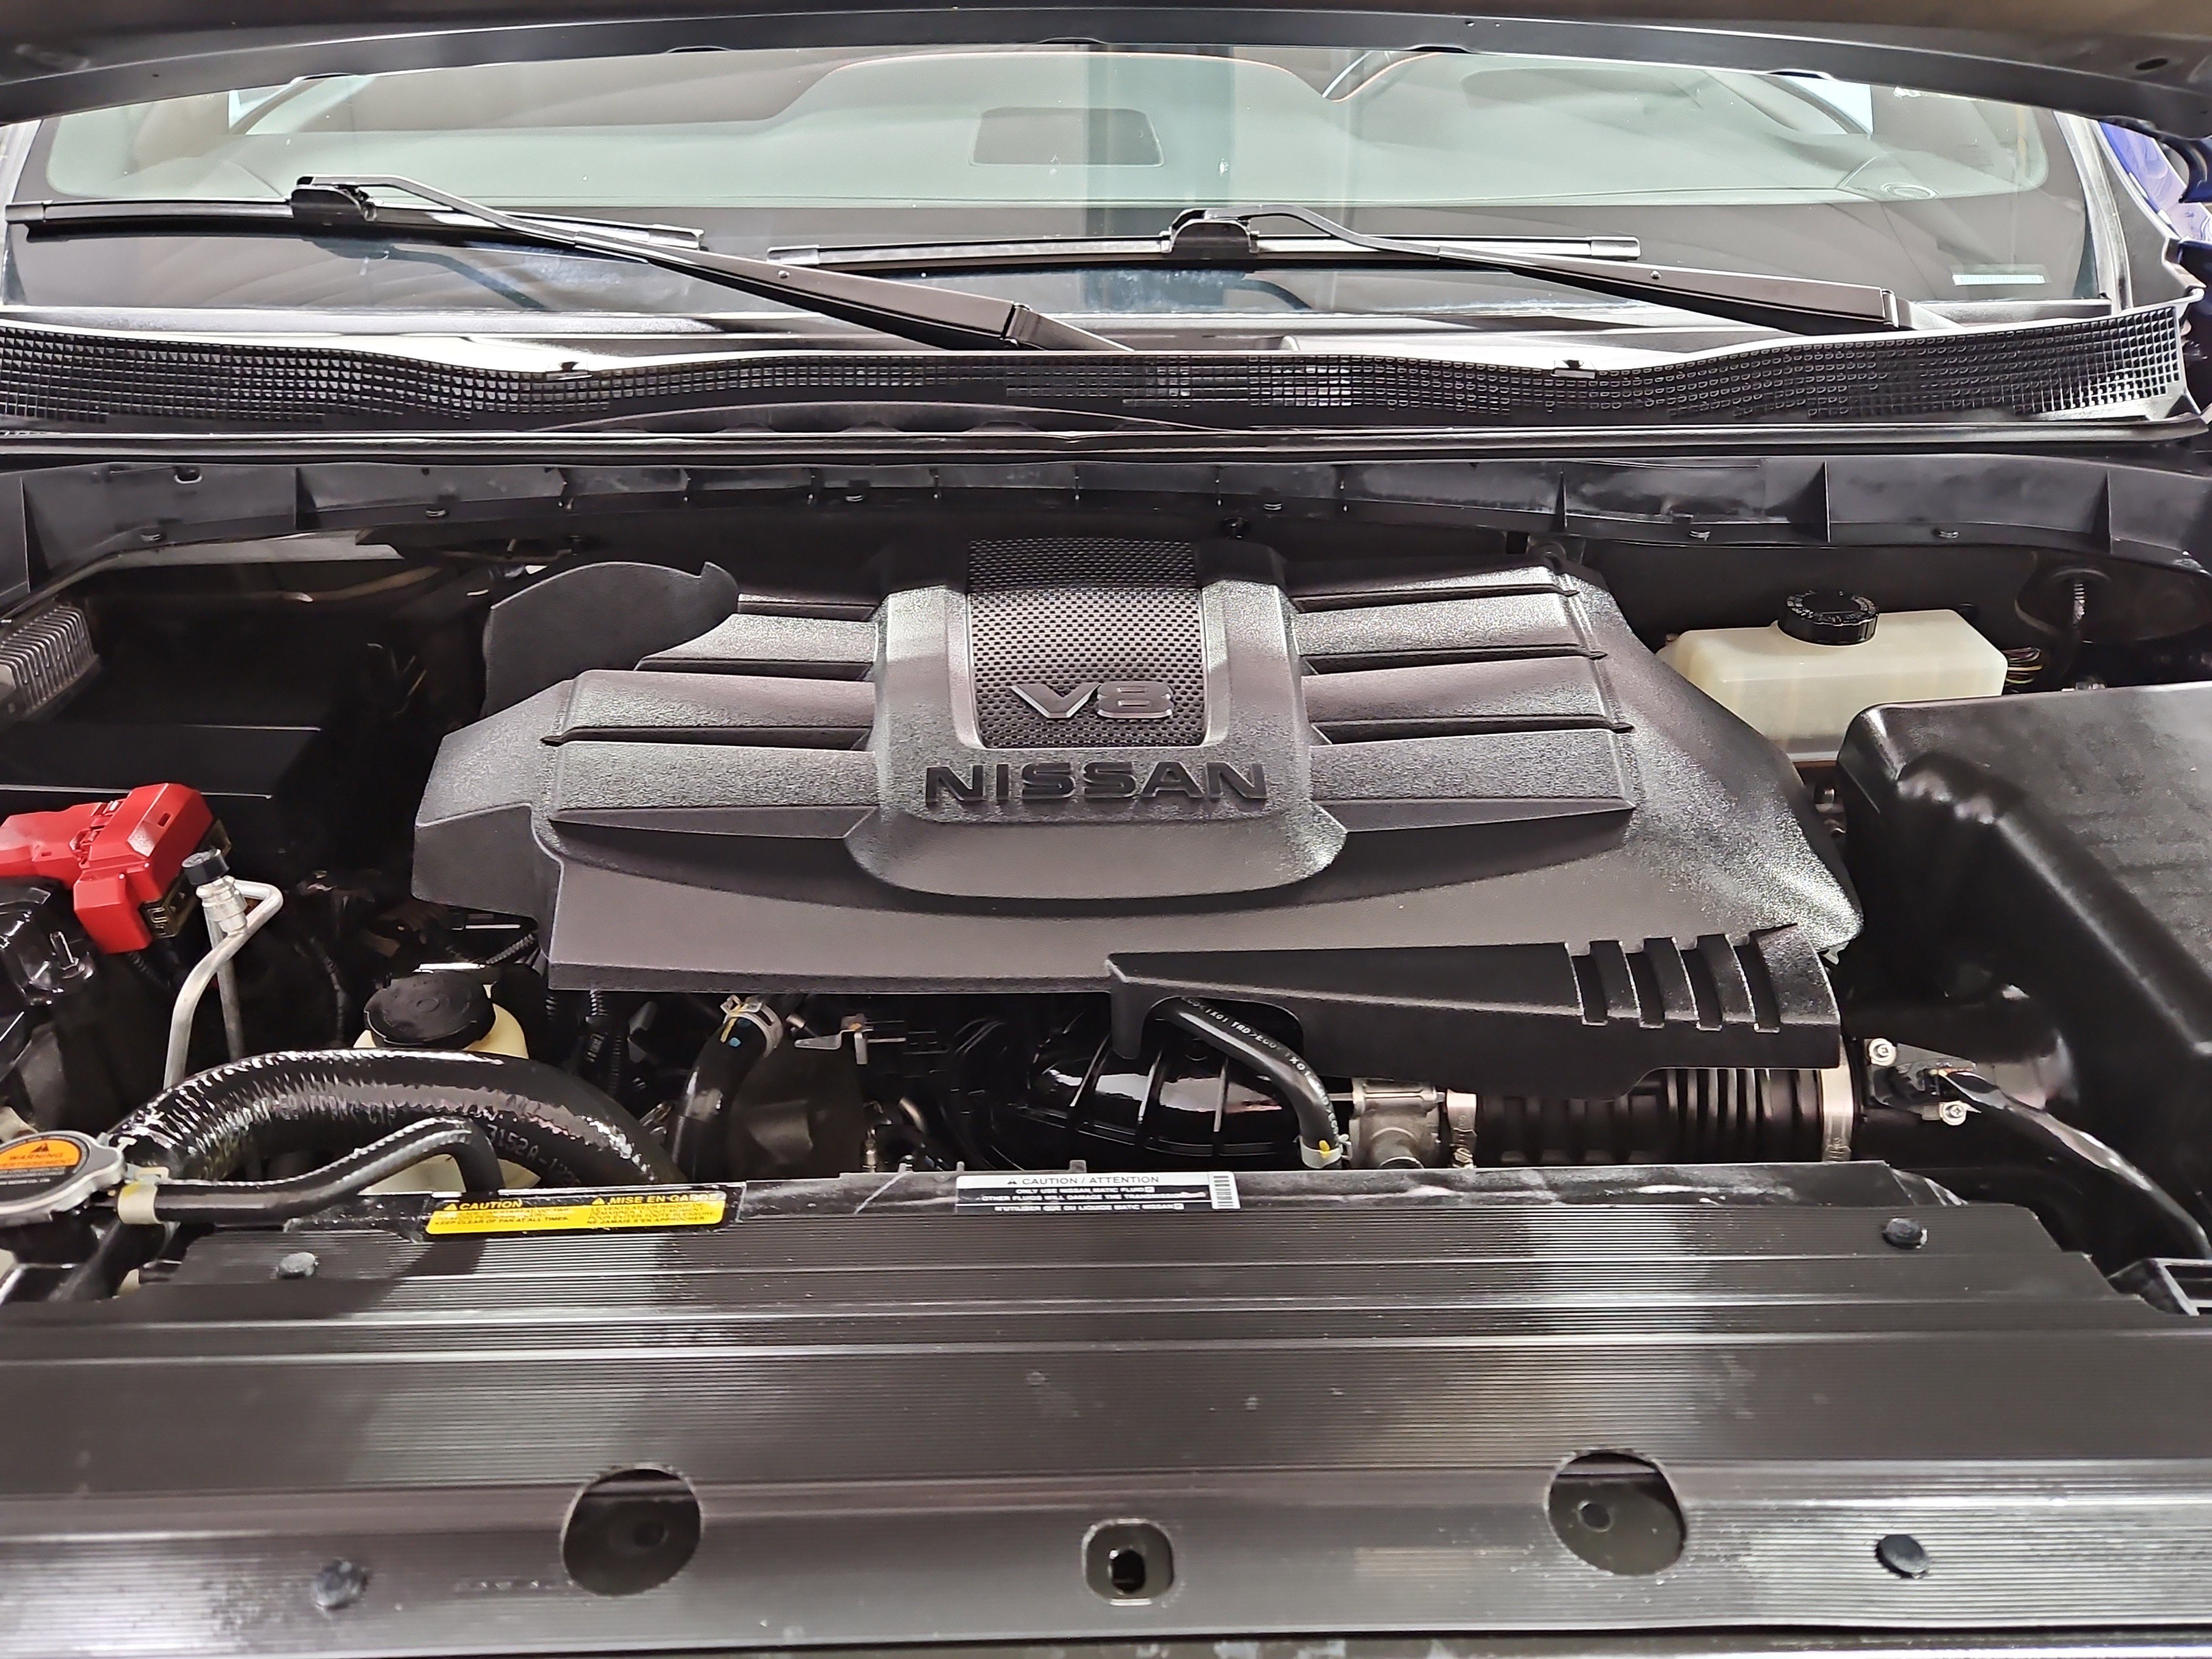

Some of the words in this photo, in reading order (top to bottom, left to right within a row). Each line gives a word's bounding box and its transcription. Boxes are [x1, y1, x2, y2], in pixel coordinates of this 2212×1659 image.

[1009, 681, 1174, 719] V8
[925, 760, 1268, 803] NISSAN
[9, 1153, 63, 1161] WARNING
[459, 1199, 522, 1210] CAUTION
[609, 1195, 643, 1205] MISE
